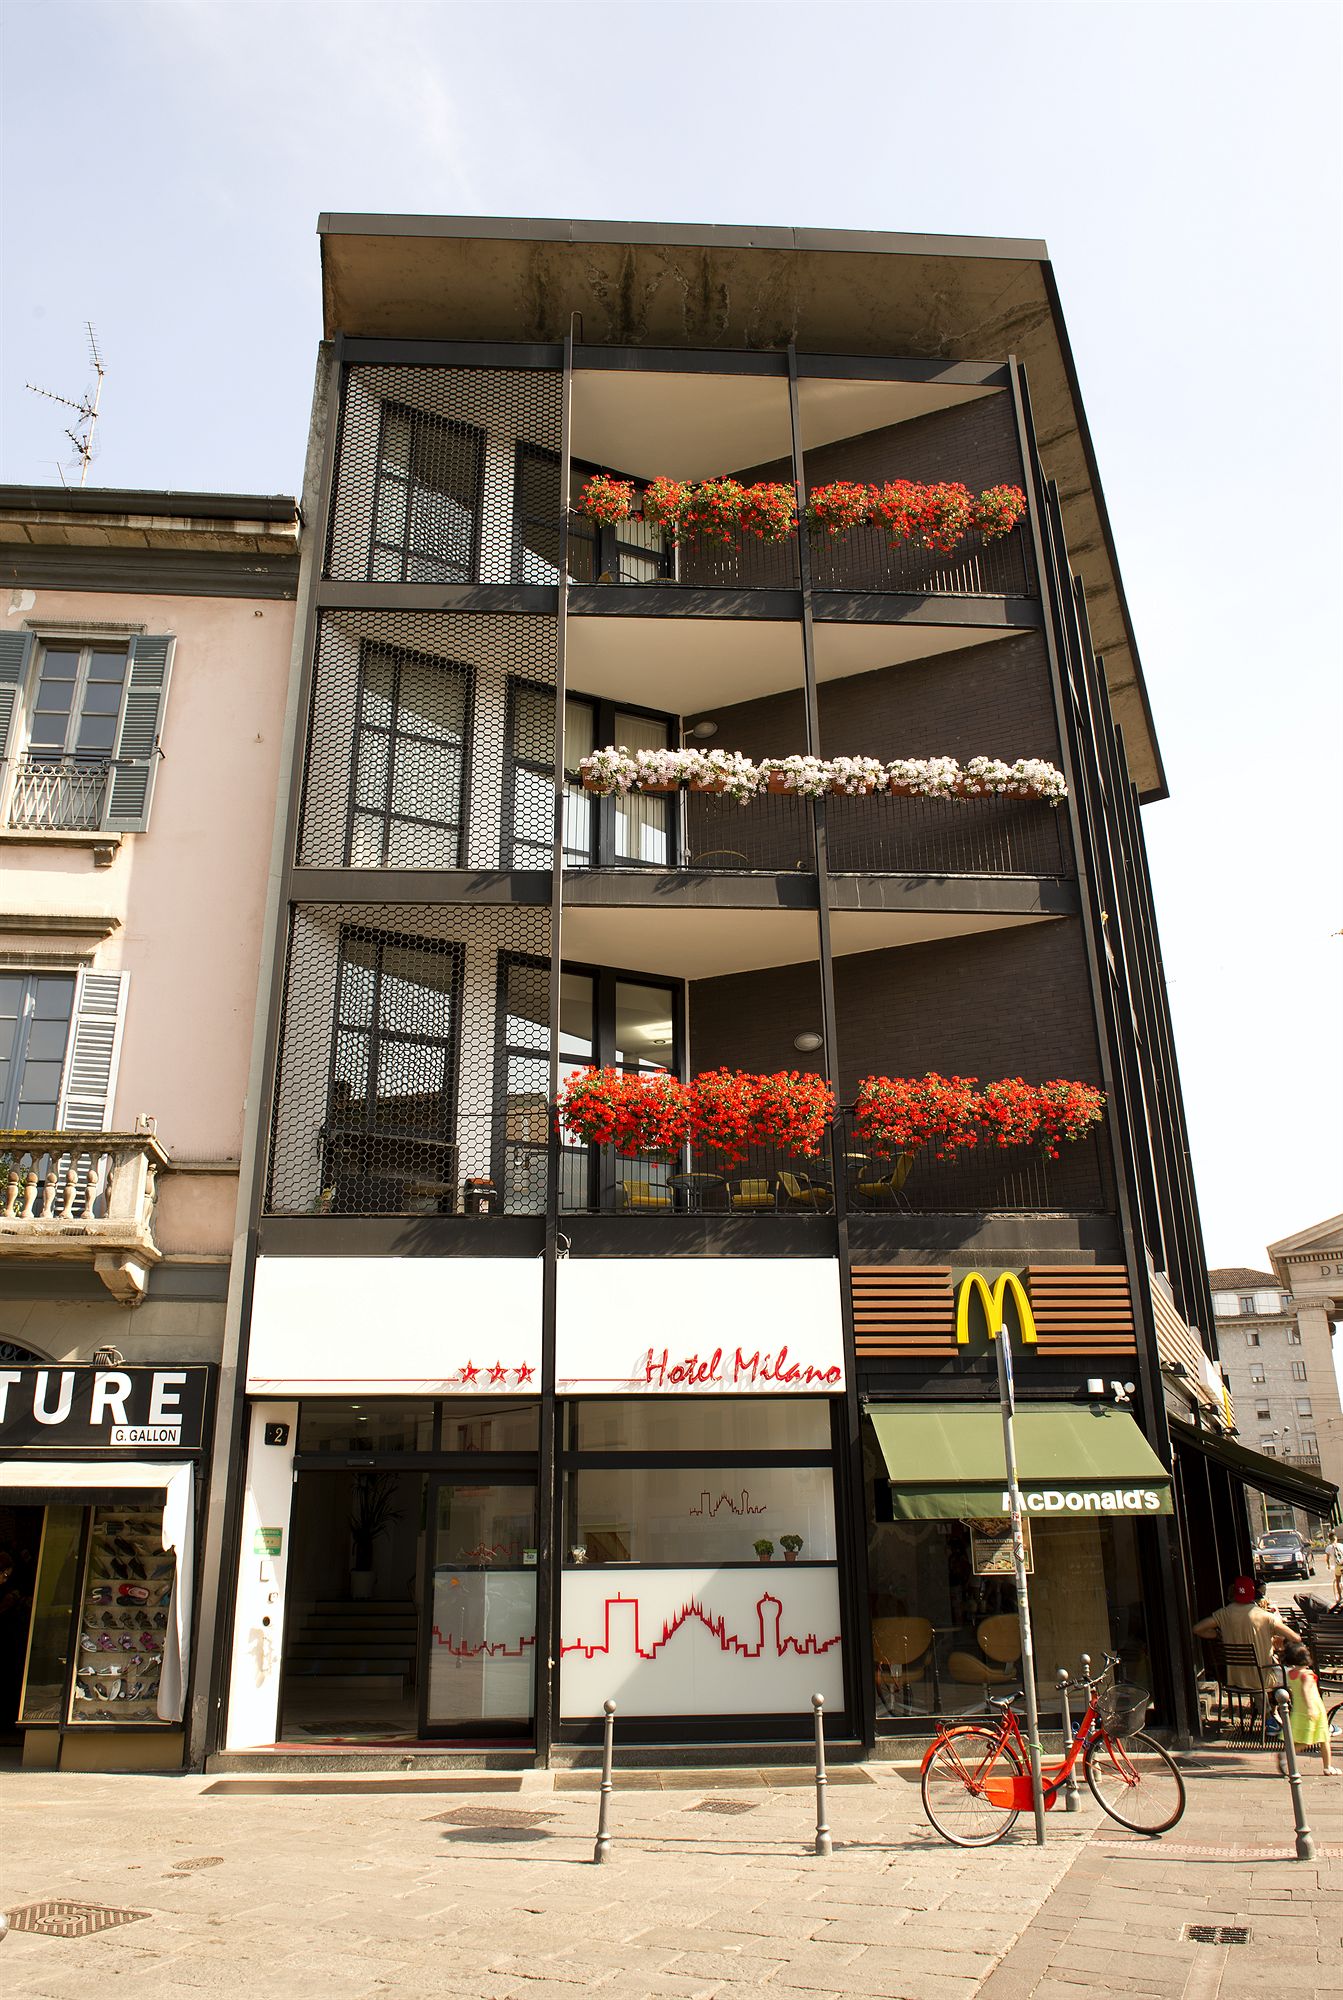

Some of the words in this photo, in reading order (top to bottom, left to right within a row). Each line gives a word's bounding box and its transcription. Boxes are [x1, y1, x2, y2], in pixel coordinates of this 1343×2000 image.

[645, 1347, 722, 1386] Hotel
[733, 1345, 841, 1383] Milano
[115, 1430, 127, 1442] G.
[129, 1429, 176, 1442] GALLON
[274, 1427, 283, 1442] 2
